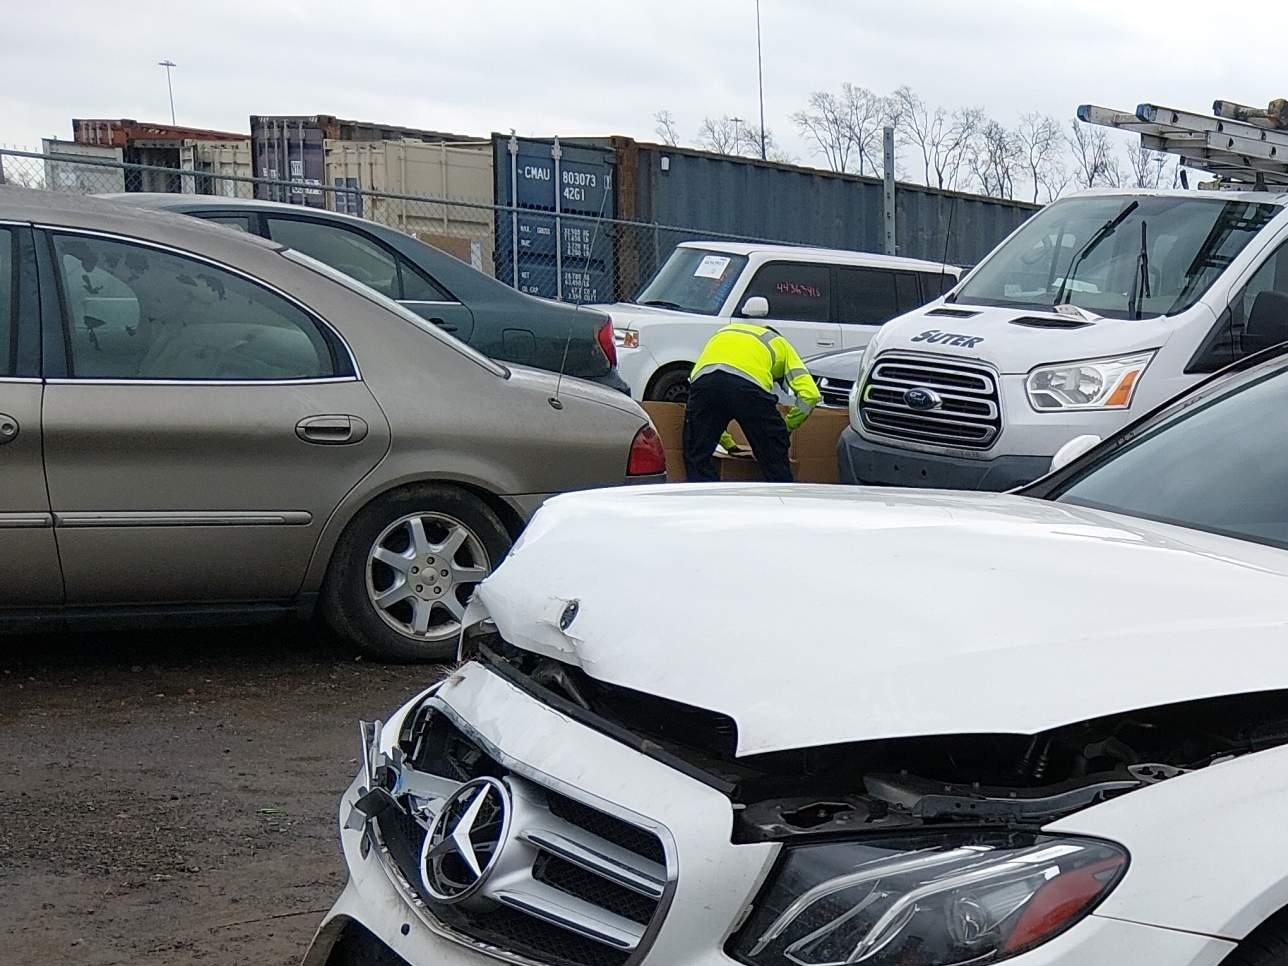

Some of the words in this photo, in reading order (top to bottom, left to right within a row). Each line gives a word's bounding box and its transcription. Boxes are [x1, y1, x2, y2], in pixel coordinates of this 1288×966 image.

[524, 166, 550, 181] CMAU
[562, 171, 596, 188] 803073
[563, 187, 585, 201] 42G1
[910, 329, 985, 348] SUTER
